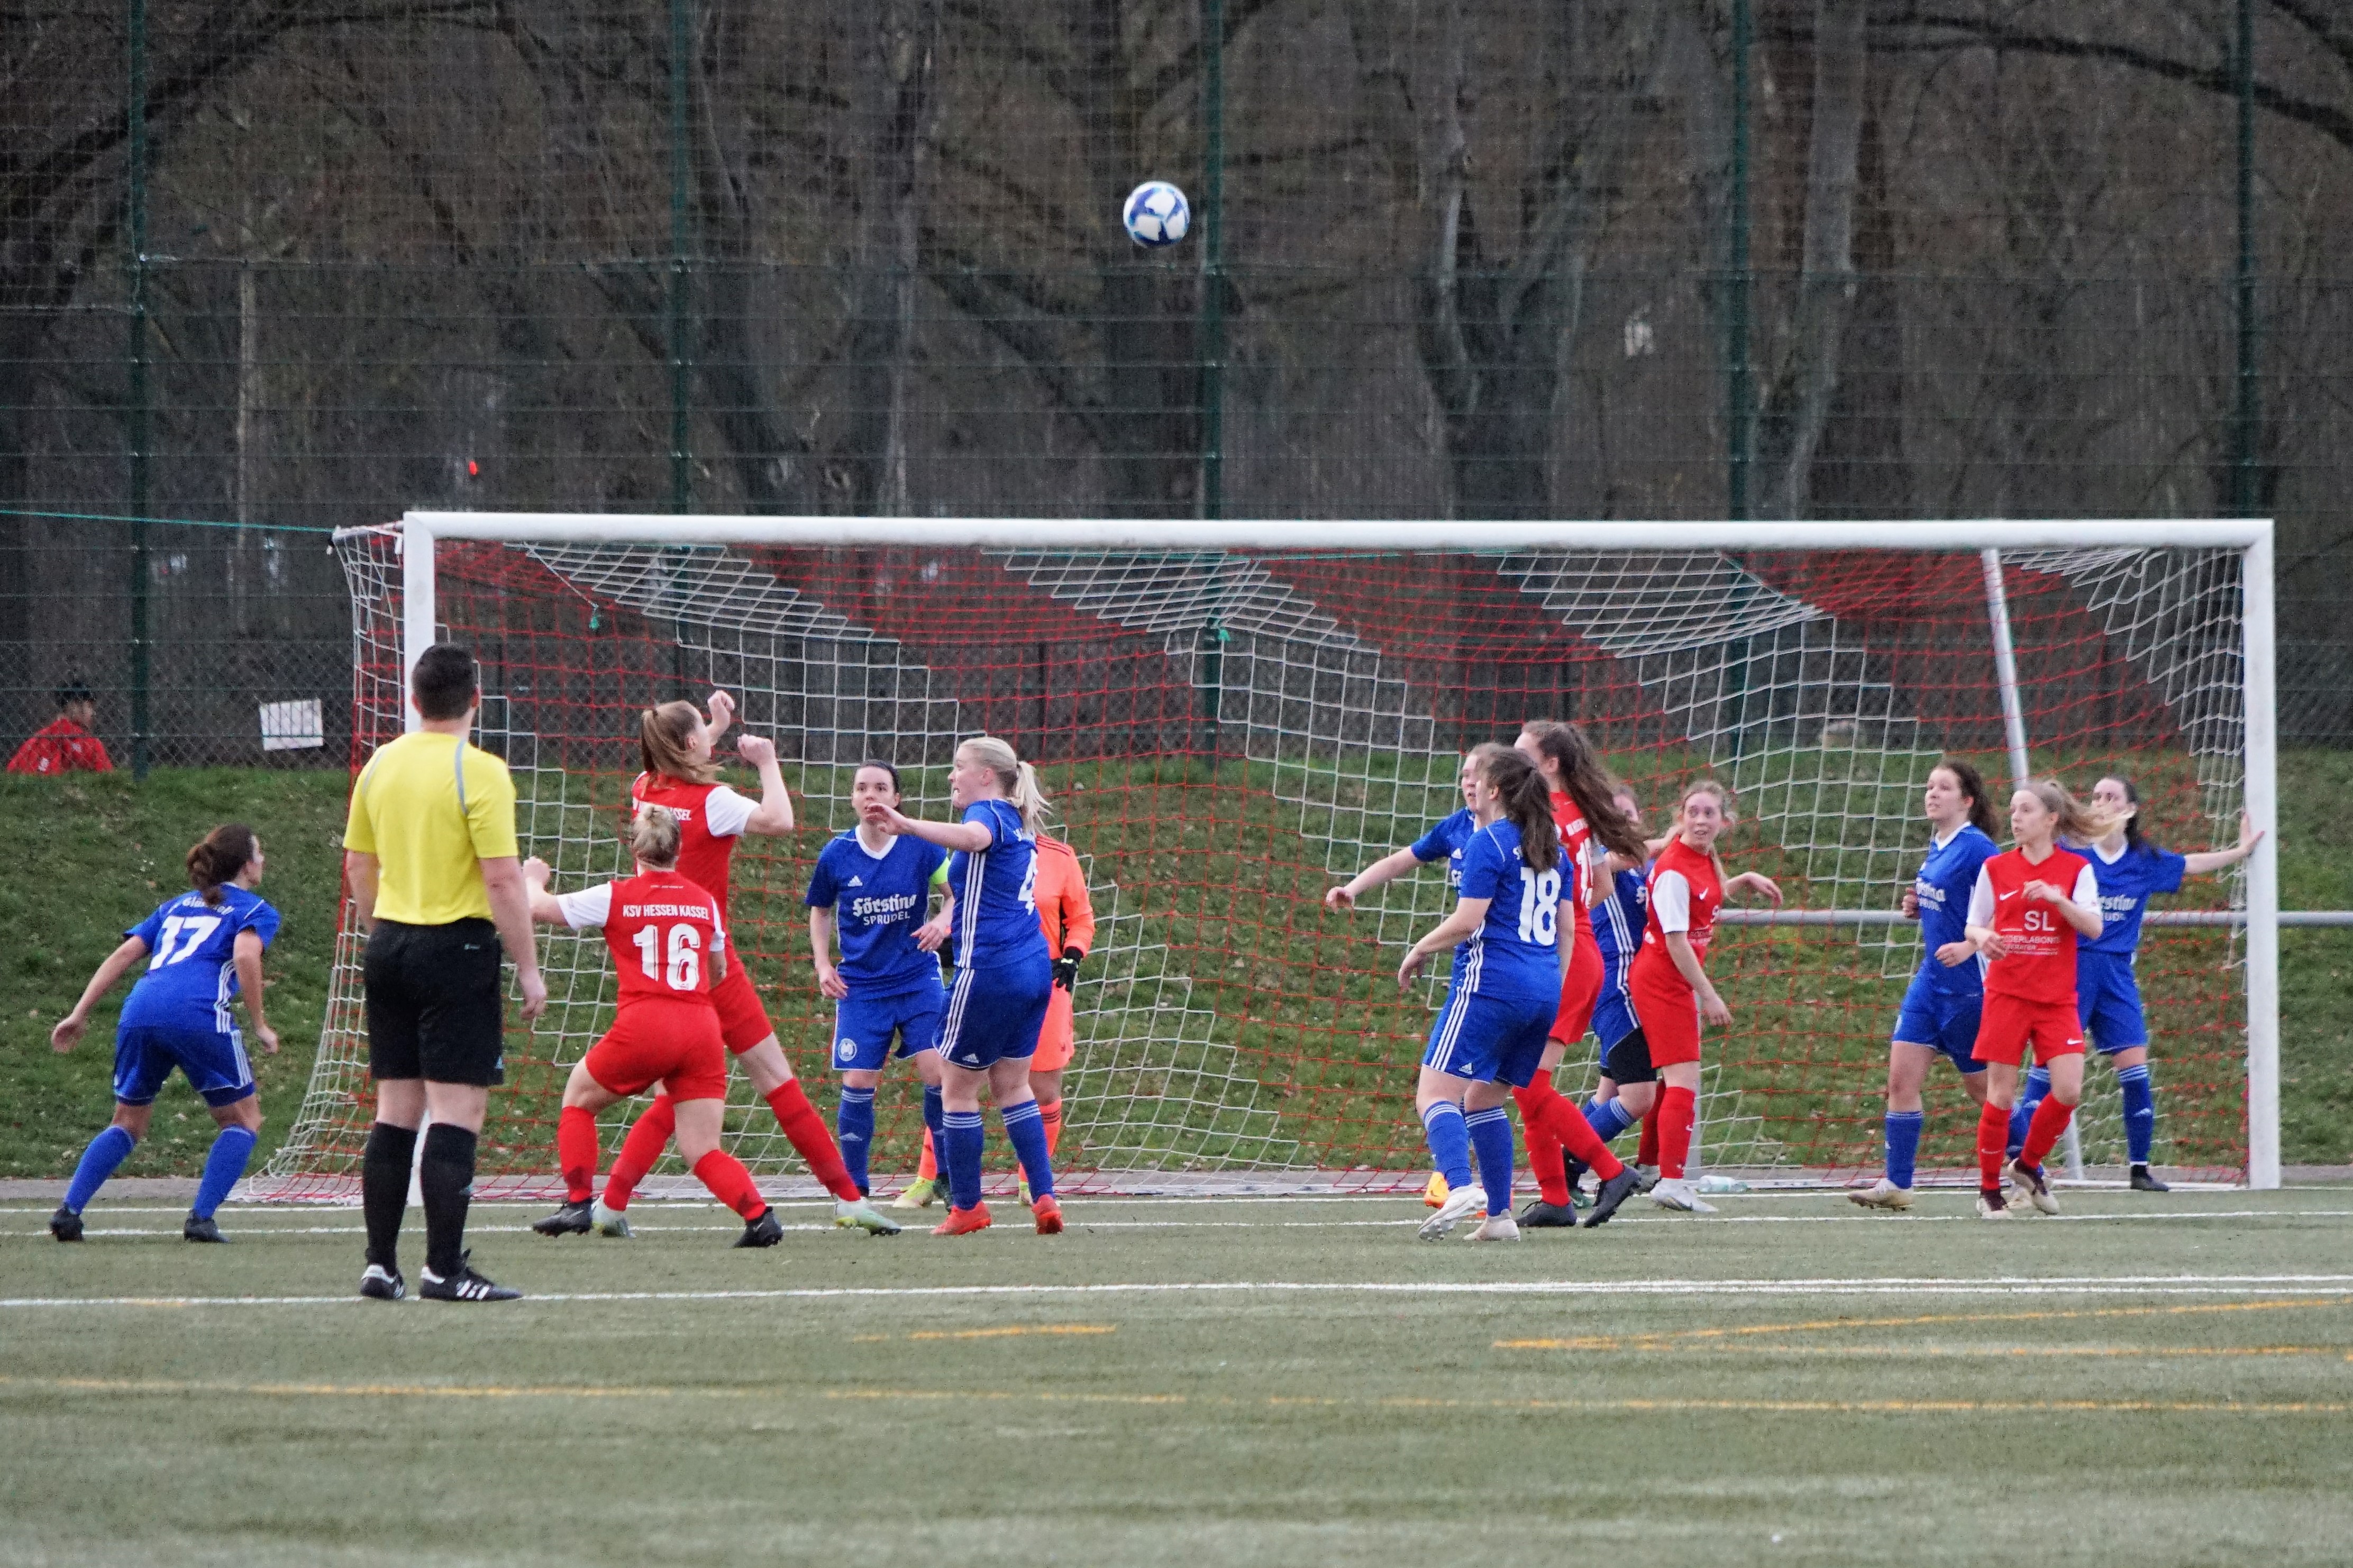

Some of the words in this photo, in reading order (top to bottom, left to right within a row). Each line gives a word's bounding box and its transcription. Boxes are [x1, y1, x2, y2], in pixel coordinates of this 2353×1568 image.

[623, 905, 641, 918] KSV
[643, 904, 678, 916] HESSEN
[679, 905, 710, 920] KASSEL
[863, 911, 910, 926] SPRUDEL
[1518, 867, 1561, 946] 18
[2024, 910, 2056, 931] SL
[149, 915, 222, 970] 17
[633, 923, 701, 991] 16
